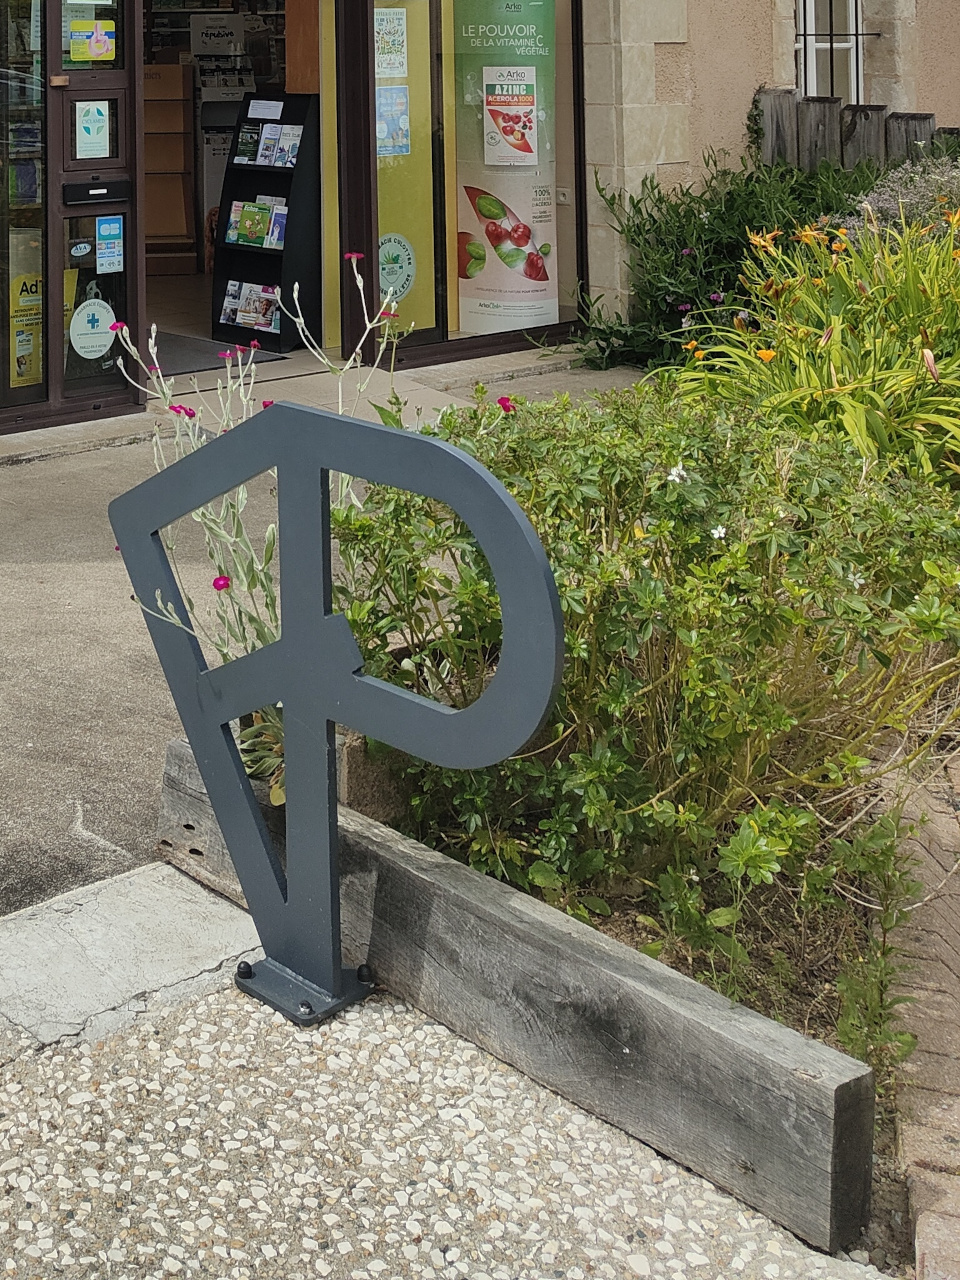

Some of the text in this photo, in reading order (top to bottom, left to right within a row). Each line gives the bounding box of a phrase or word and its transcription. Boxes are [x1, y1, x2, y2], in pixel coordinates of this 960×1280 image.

[505, 2, 522, 10] Arko
[201, 30, 234, 40] répulsive
[462, 24, 537, 37] LE POUVOIR
[470, 34, 544, 47] DE LA VITAMINE C
[515, 46, 550, 56] VÉGÉTALE
[506, 70, 526, 79] Arko
[495, 84, 527, 95] AZINC
[534, 189, 551, 197] 100%
[100, 223, 120, 236] CB
[378, 238, 392, 250] ACIE
[19, 278, 42, 296] Ad
